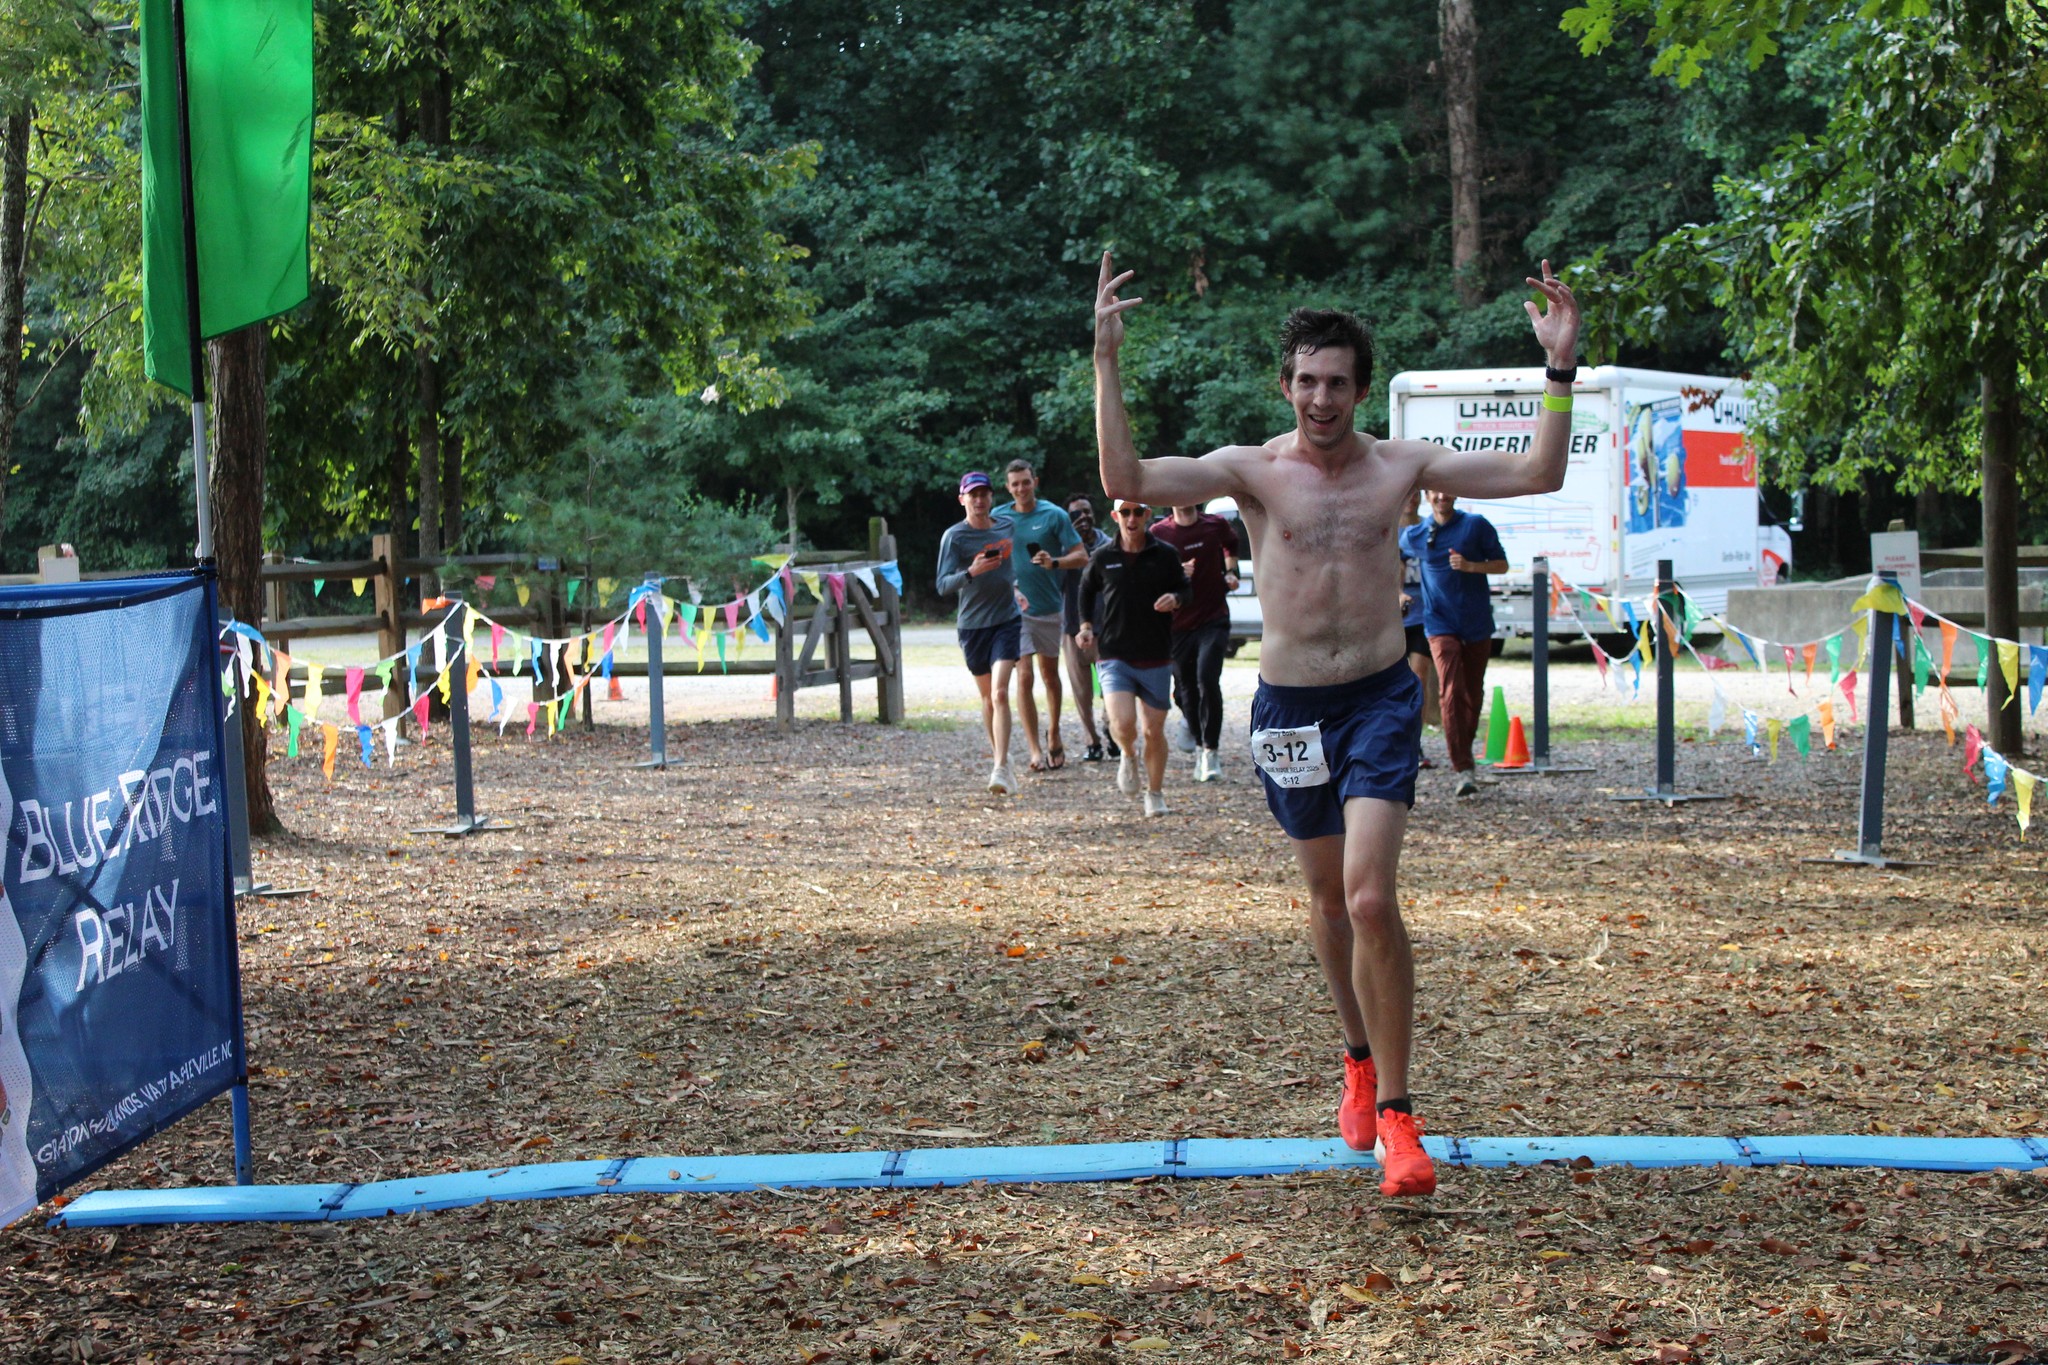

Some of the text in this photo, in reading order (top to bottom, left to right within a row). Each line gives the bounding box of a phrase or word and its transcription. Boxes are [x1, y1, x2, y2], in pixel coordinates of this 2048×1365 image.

[1451, 434, 1598, 454] SUPERMER
[1263, 741, 1309, 763] 3-12
[1282, 776, 1300, 785] 3-12
[20, 786, 121, 885] BLUE
[75, 877, 180, 993] RELAY
[139, 1082, 162, 1104] VA
[221, 1039, 233, 1062] NC
